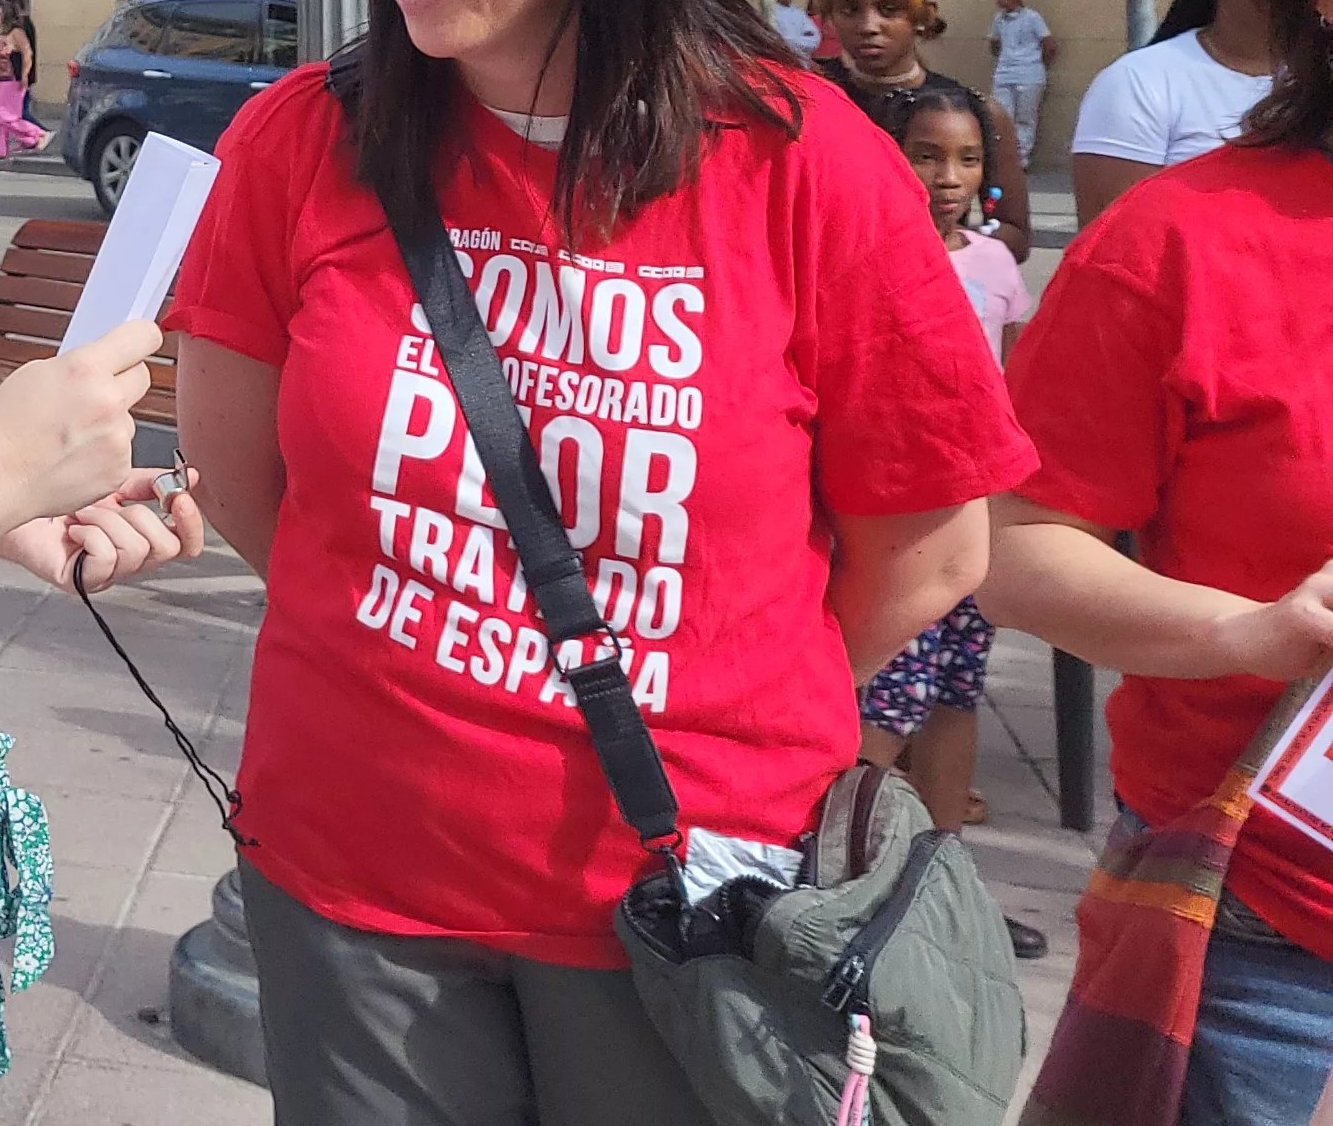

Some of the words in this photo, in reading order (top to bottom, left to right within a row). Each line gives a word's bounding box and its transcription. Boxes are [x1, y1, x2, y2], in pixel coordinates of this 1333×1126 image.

[446, 227, 502, 251] RAGÓN
[396, 334, 439, 376] EL
[503, 357, 703, 430] OFESORADO
[356, 563, 434, 651] DE
